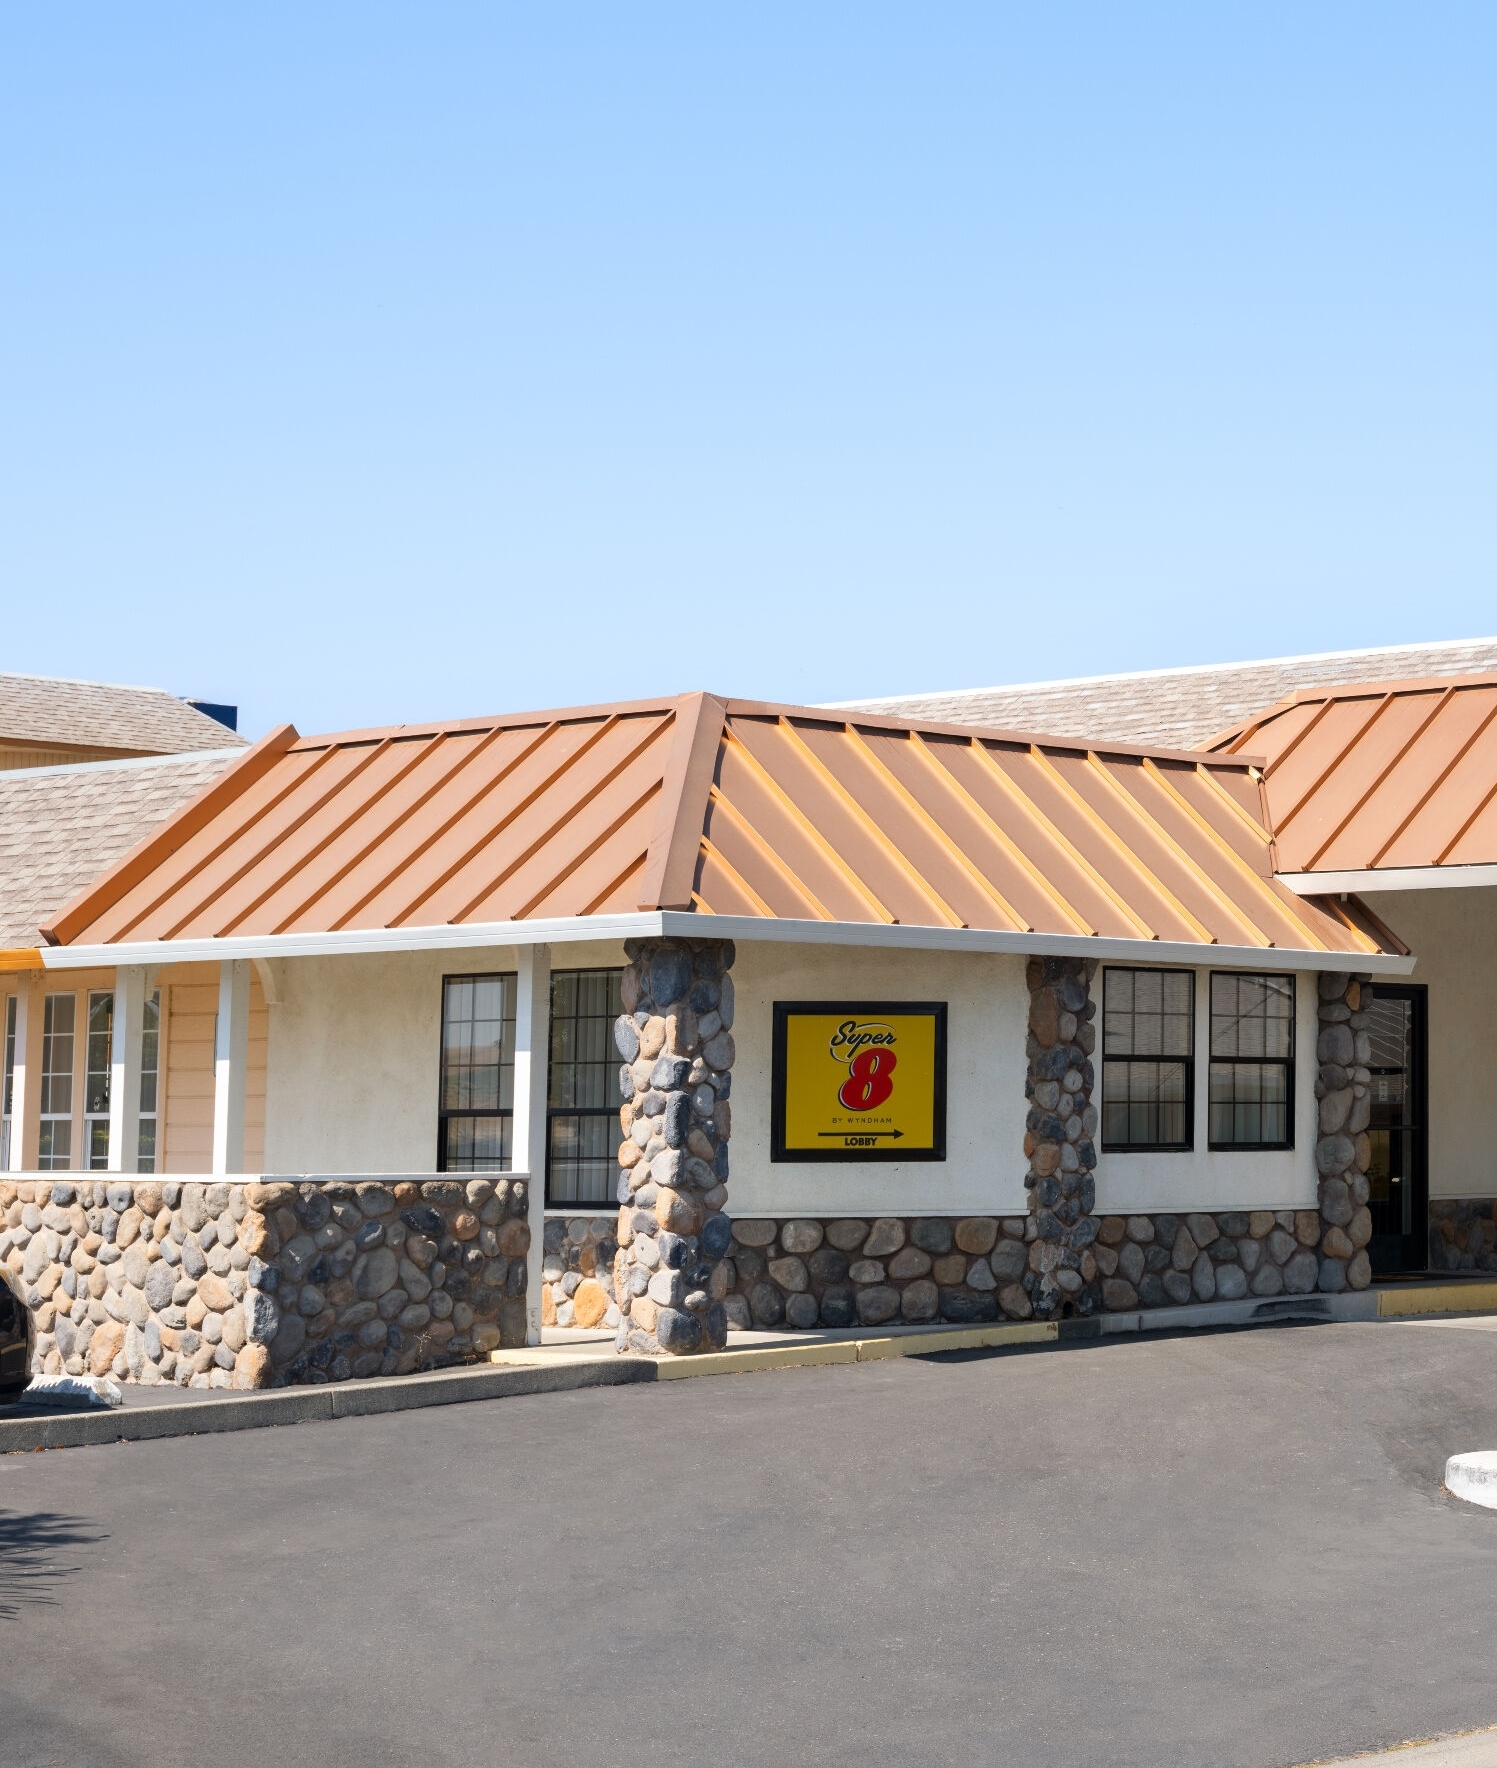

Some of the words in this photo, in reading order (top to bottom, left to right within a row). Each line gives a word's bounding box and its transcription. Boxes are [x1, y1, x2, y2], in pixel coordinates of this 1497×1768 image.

[830, 1020, 897, 1060] Super
[838, 1047, 897, 1111] 8
[844, 1137, 877, 1147] LOBBY
